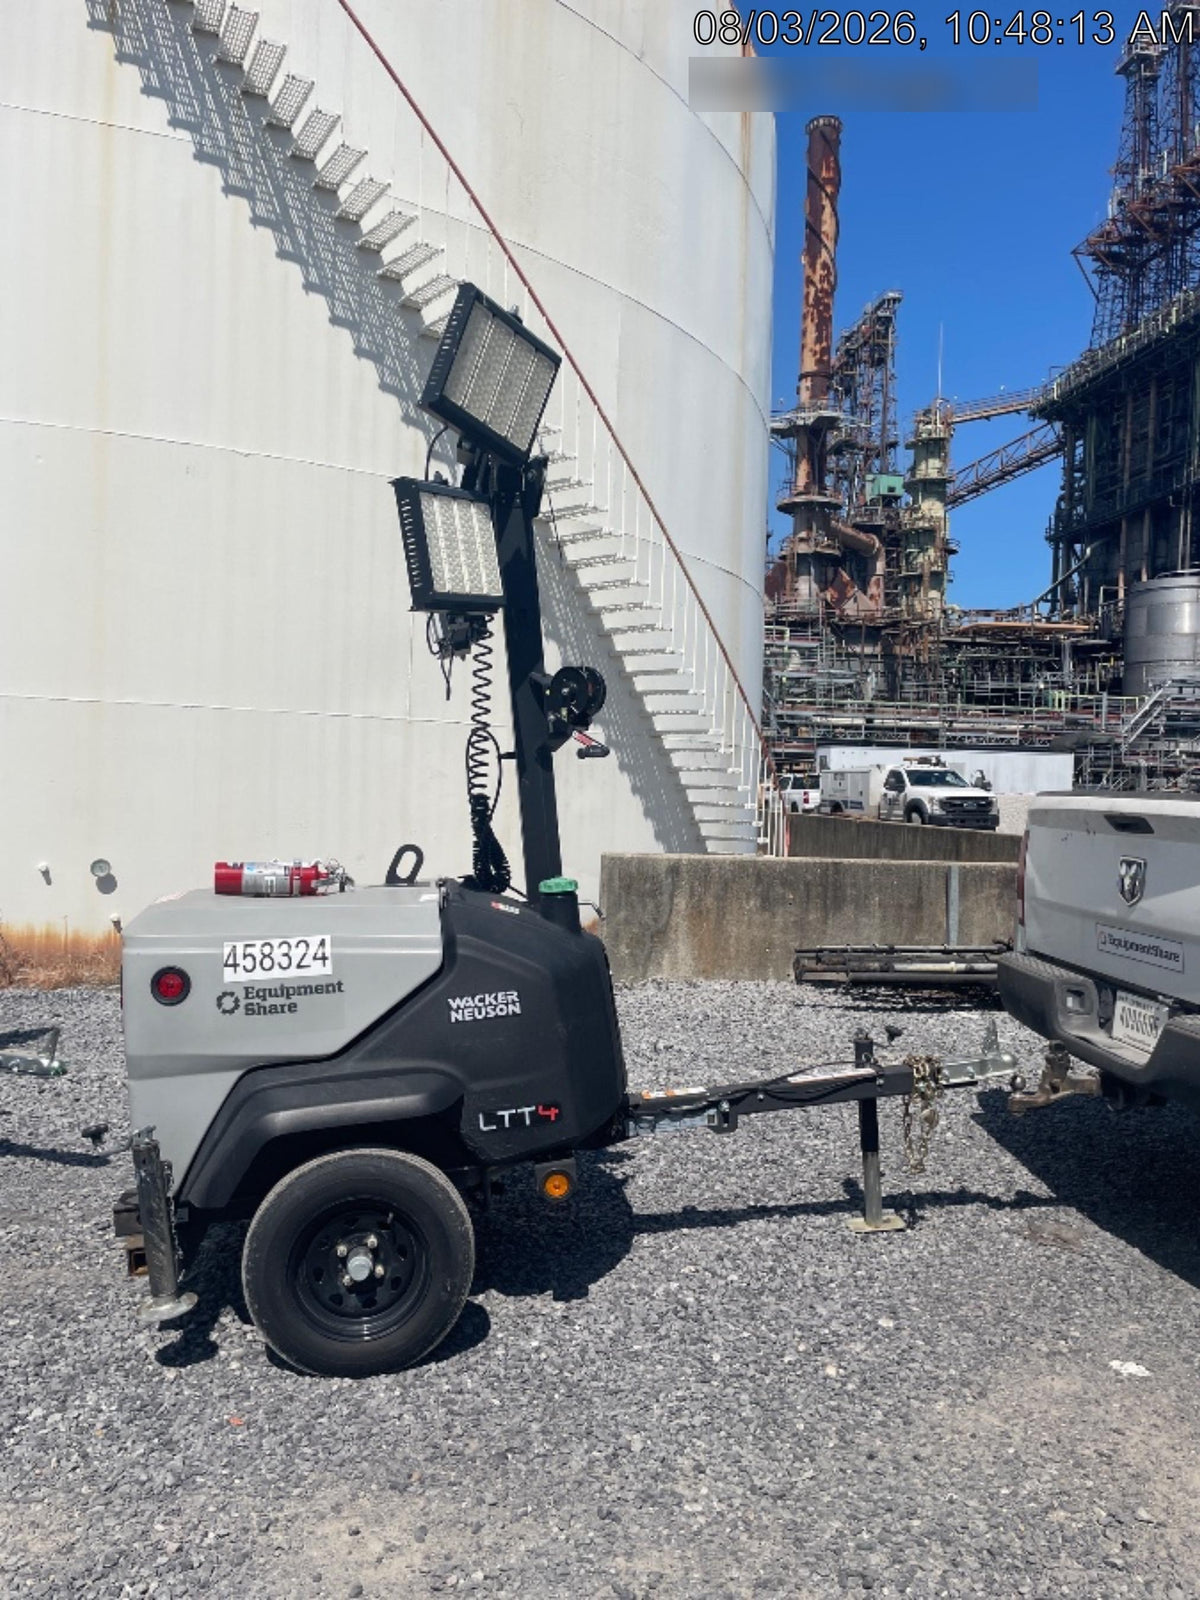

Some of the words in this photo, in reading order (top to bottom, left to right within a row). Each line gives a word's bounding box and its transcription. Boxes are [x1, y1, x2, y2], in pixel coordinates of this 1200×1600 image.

[223, 938, 330, 975] 458324
[243, 980, 344, 1001] Equipment
[448, 991, 520, 1010] WACKER
[244, 1000, 298, 1016] Share
[450, 1002, 522, 1023] NEUSON
[478, 1104, 560, 1132] LTT4
